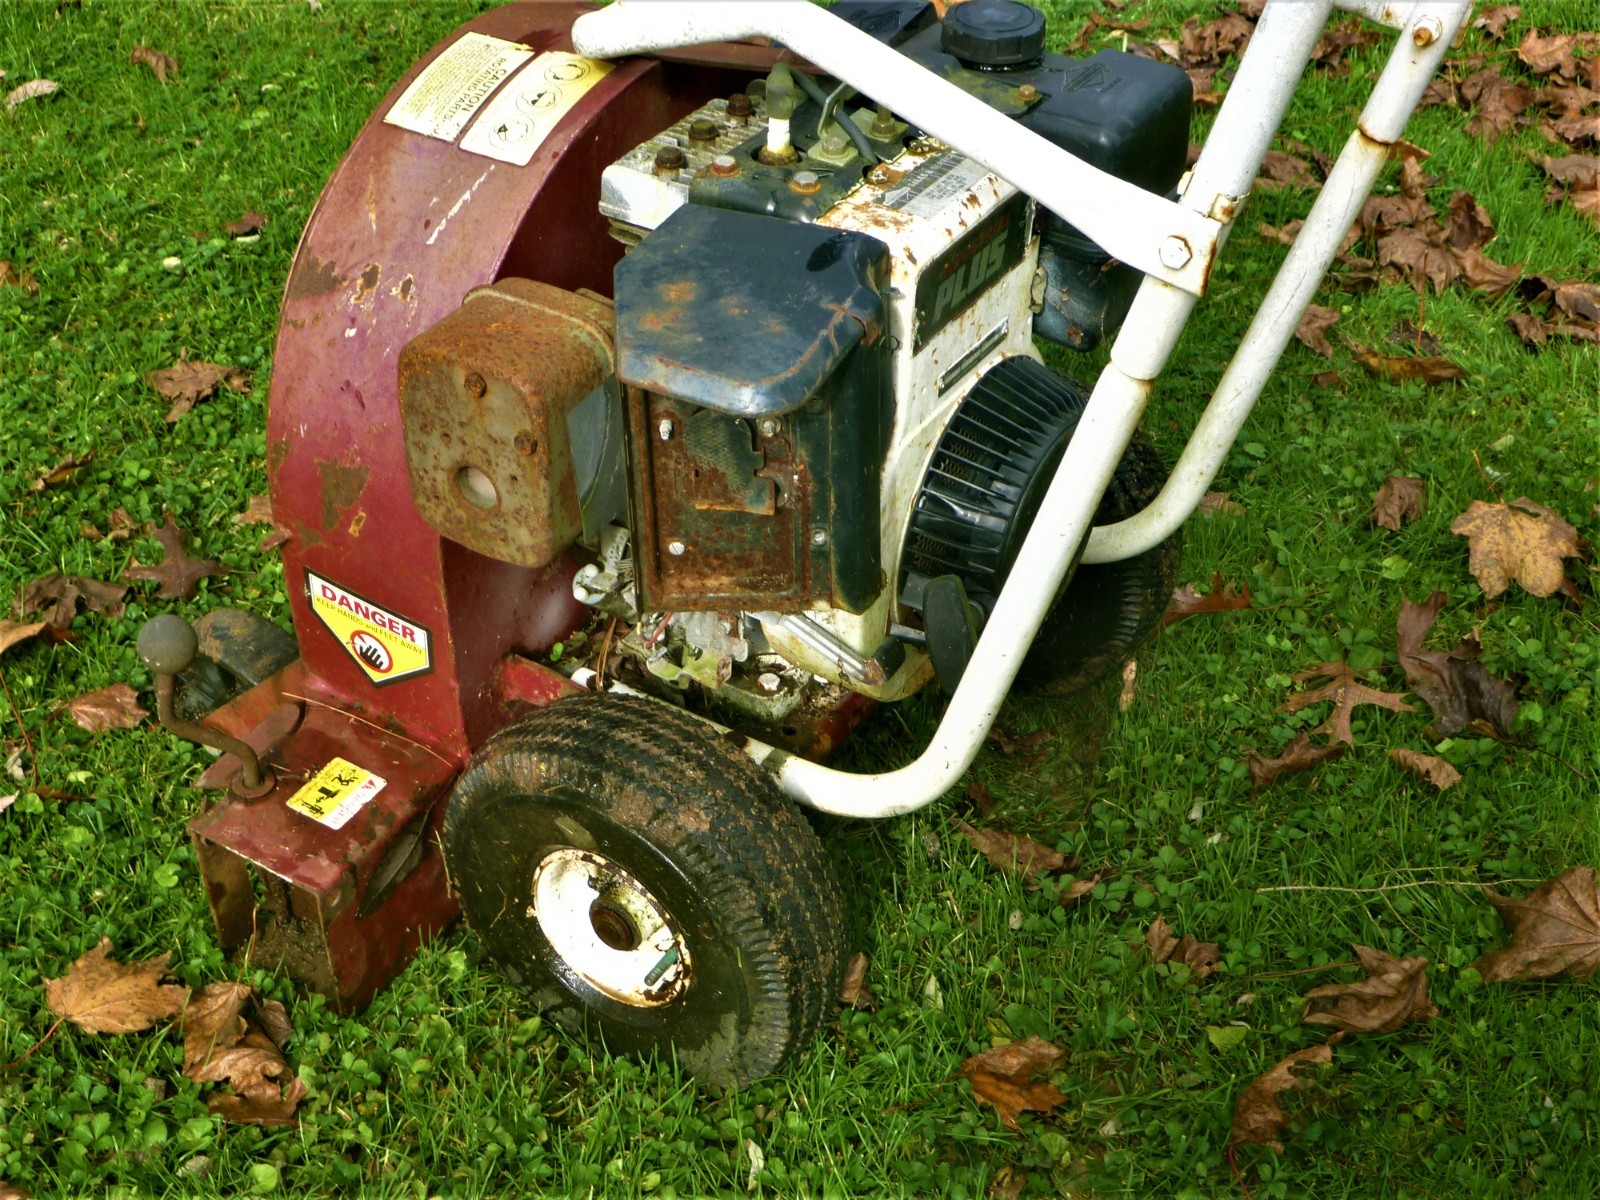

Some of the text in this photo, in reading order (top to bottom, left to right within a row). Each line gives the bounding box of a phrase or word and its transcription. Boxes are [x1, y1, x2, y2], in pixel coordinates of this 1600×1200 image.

[461, 68, 507, 112] CAUTION
[468, 57, 507, 91] ROTATING
[932, 229, 1008, 326] PLUS
[316, 597, 423, 655] KEEP HANDS and FEET AWAY
[321, 584, 416, 643] DANGER
